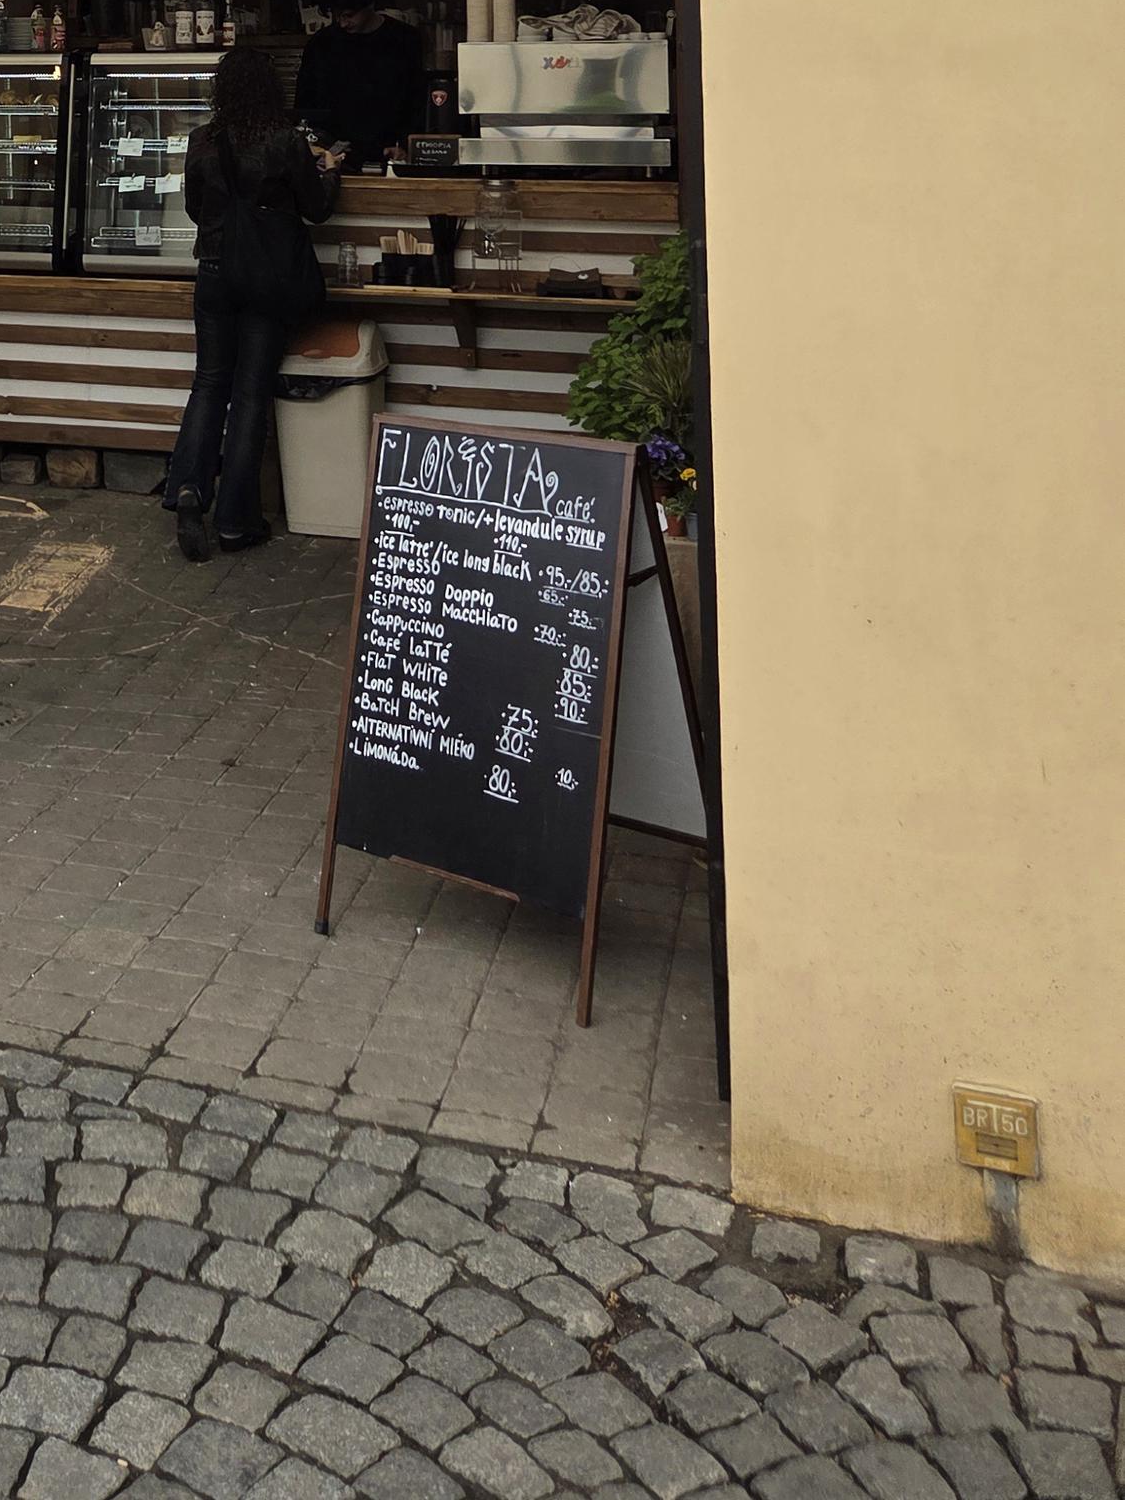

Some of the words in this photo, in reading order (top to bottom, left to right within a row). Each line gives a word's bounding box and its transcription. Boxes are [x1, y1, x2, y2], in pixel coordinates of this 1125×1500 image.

[377, 428, 559, 512] FLORISTA
[383, 495, 434, 517] espresso
[566, 525, 606, 548] syrup
[378, 531, 395, 549] ice
[463, 549, 490, 573] long
[378, 552, 440, 575] Espresso
[375, 571, 435, 595] Espresso
[374, 590, 432, 614] Espresso
